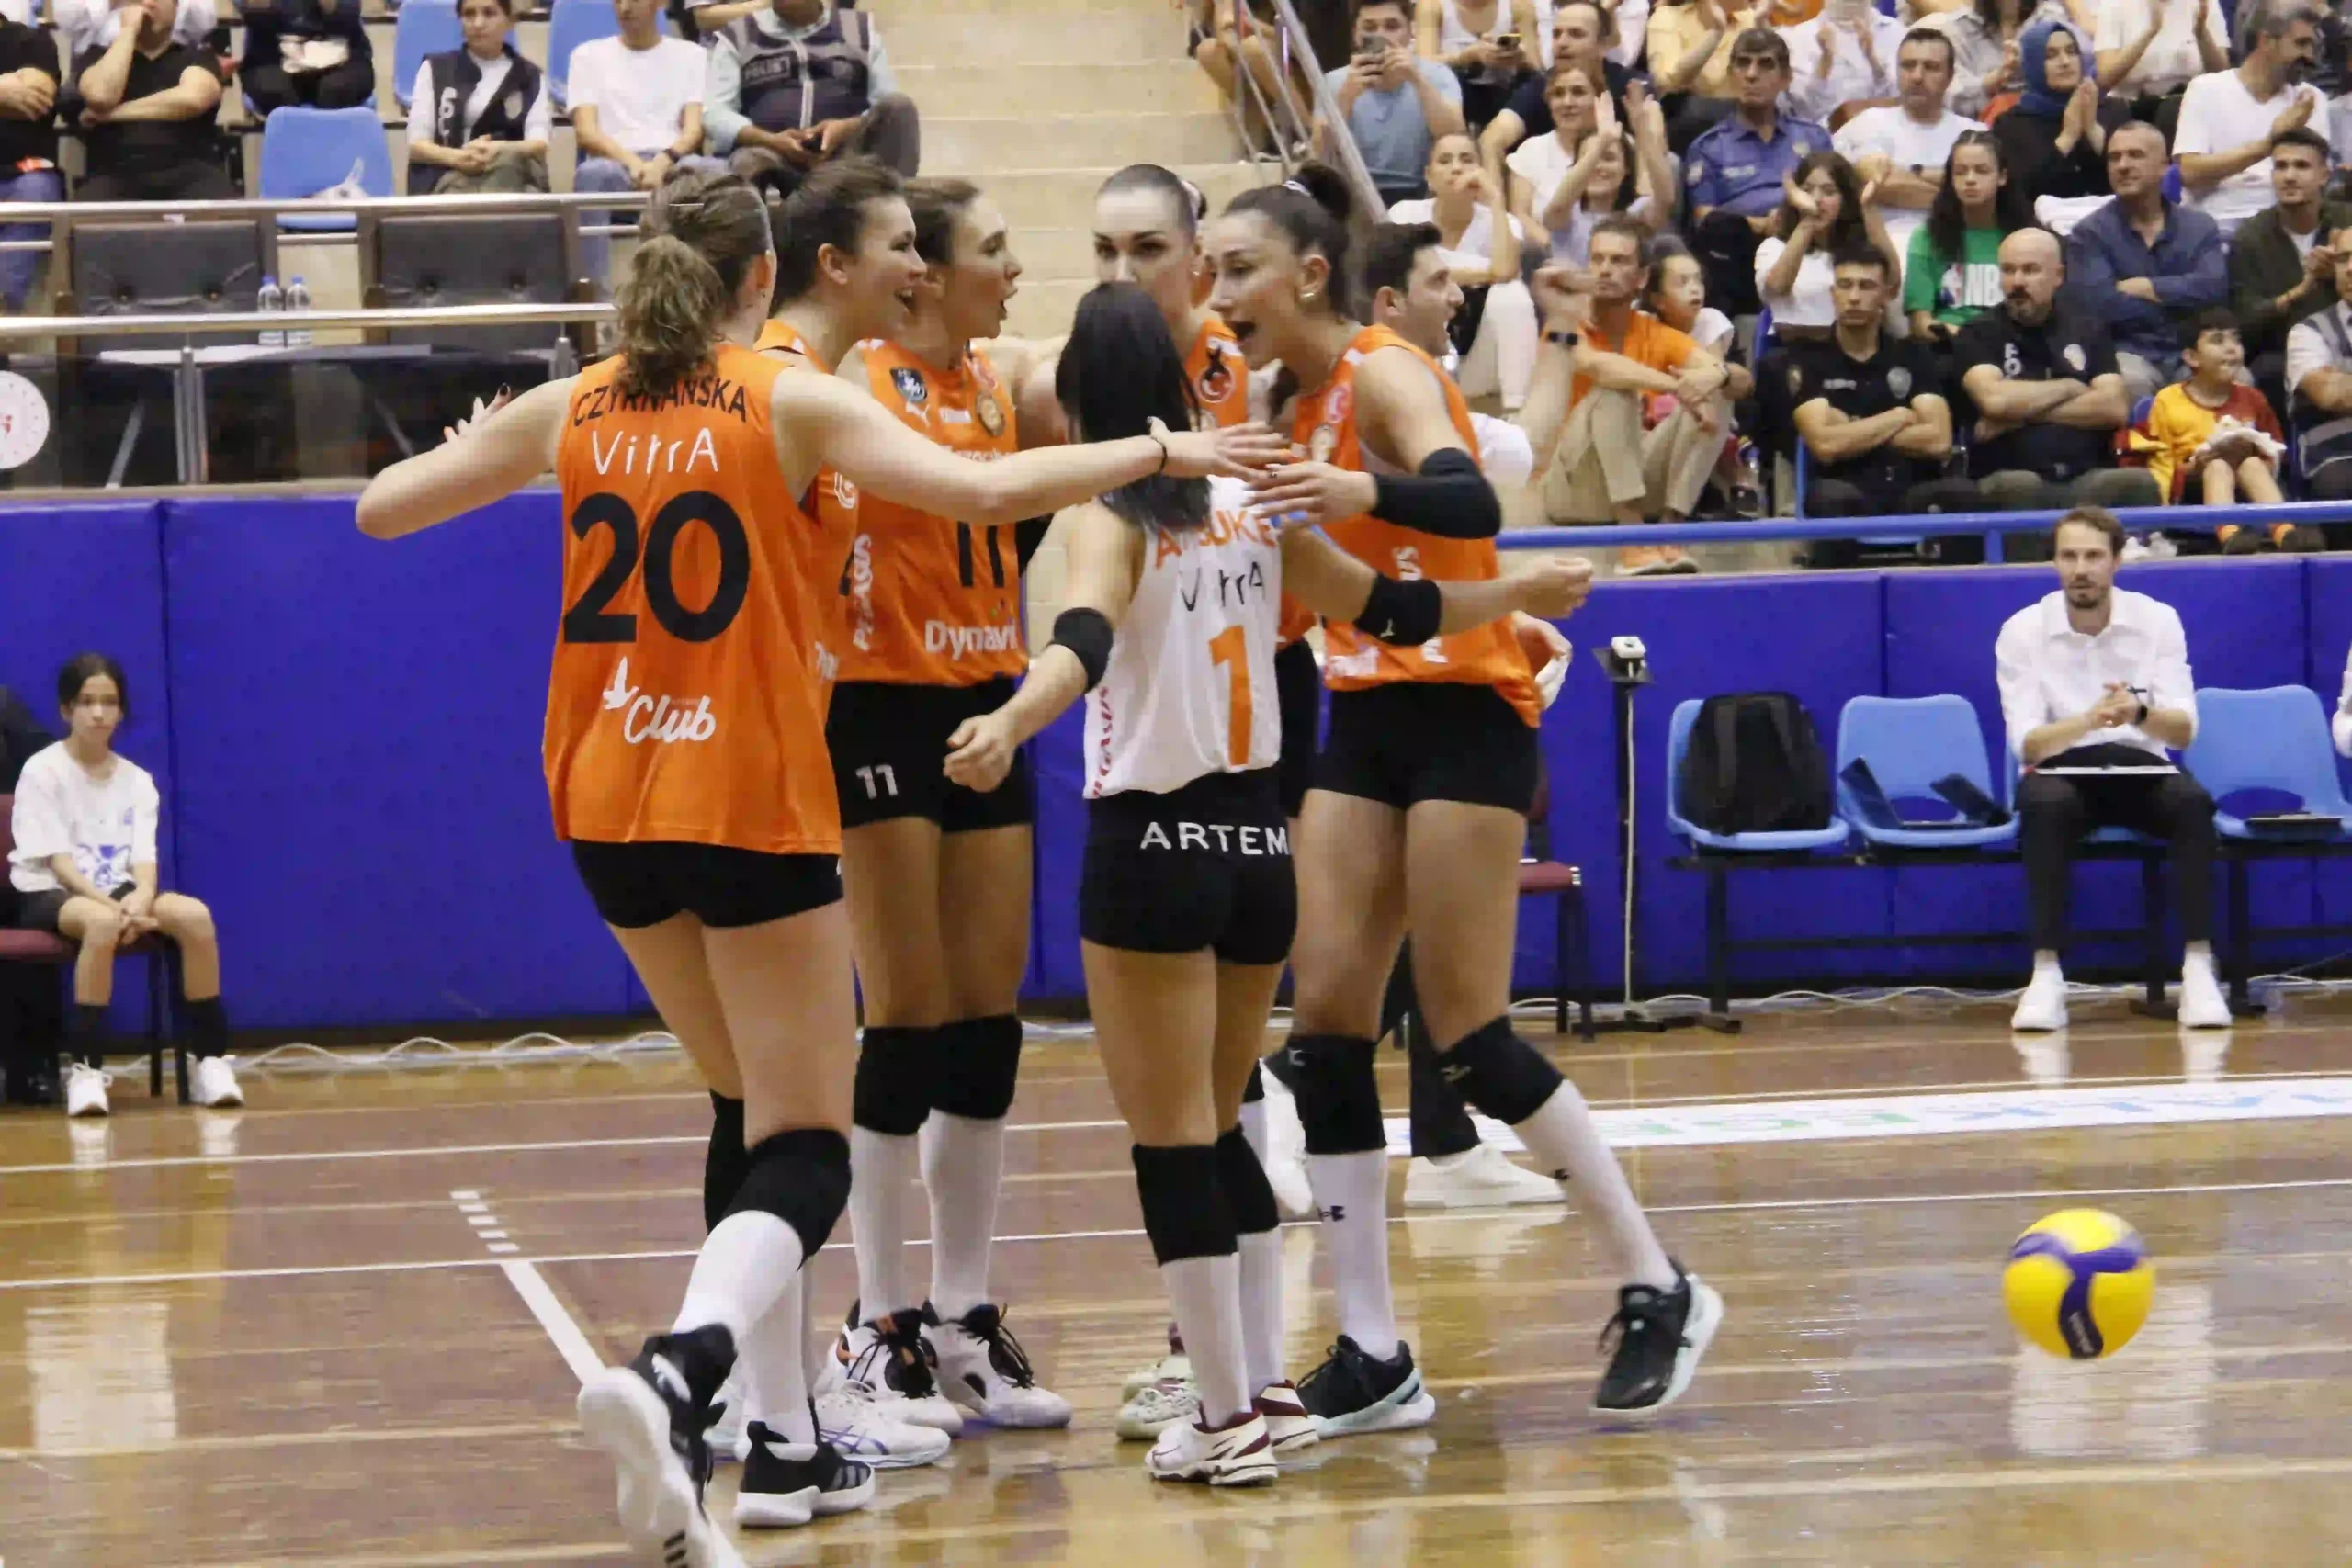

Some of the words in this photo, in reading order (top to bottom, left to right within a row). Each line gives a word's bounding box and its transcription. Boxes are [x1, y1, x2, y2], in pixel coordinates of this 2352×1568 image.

[1964, 263, 2006, 306] NB
[563, 490, 751, 643] 20
[624, 694, 717, 744] Club
[1209, 625, 1253, 767] 1
[855, 764, 899, 800] 11
